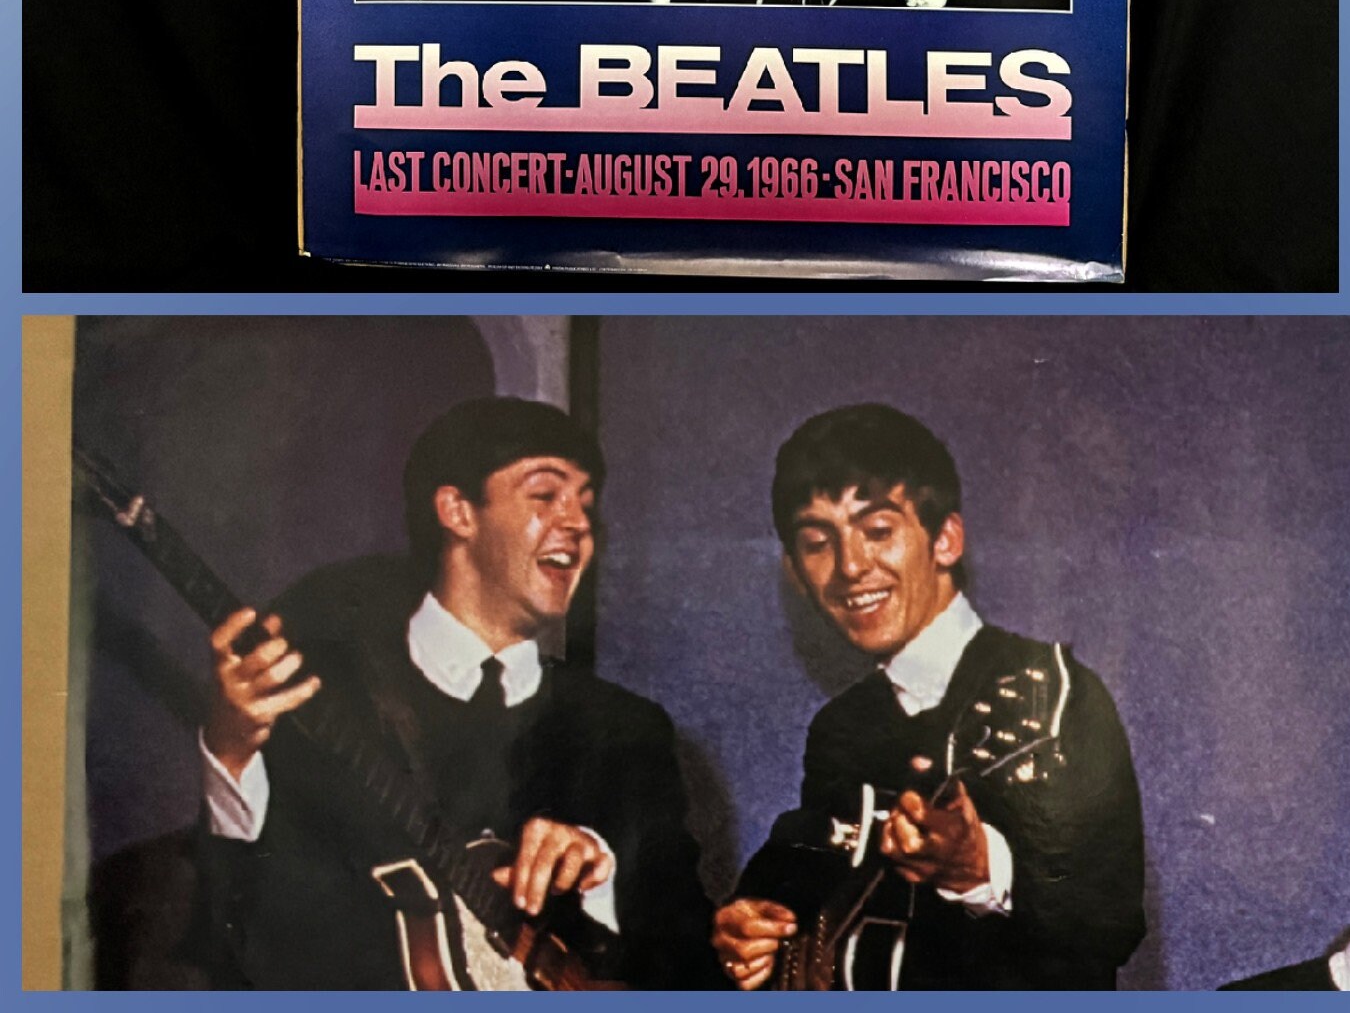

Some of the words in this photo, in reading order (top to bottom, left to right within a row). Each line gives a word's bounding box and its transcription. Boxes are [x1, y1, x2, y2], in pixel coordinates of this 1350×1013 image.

[354, 43, 547, 109] The
[580, 43, 1072, 120] BEATLES
[354, 150, 425, 192] LAST
[903, 160, 1071, 203] FRANCISCO
